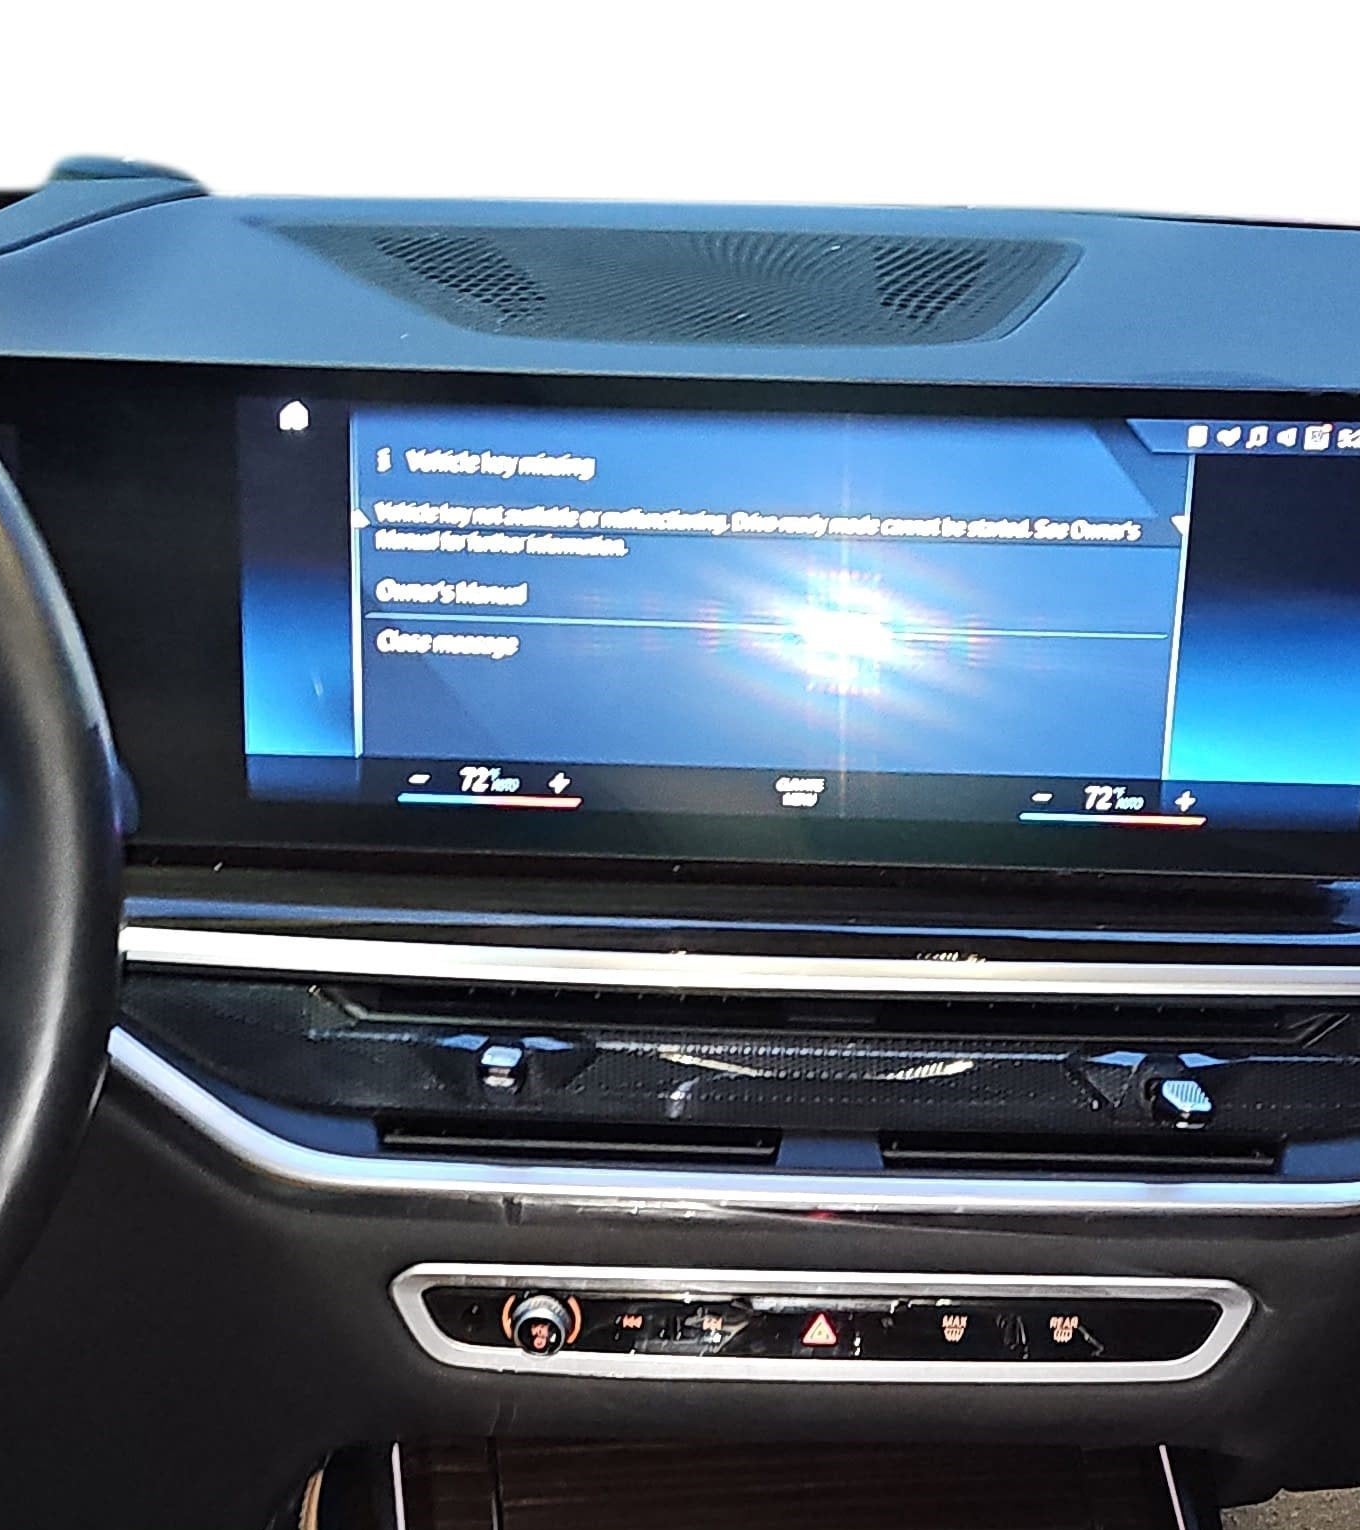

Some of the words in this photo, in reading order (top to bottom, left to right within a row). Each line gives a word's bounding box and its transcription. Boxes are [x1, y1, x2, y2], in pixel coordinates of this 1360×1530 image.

[404, 449, 481, 475] Vehicle
[481, 450, 518, 479] key
[518, 453, 596, 480] missing
[374, 501, 440, 526] Vehicle
[375, 577, 457, 604] Owner's
[455, 580, 529, 606] Manual
[376, 627, 433, 654] Close
